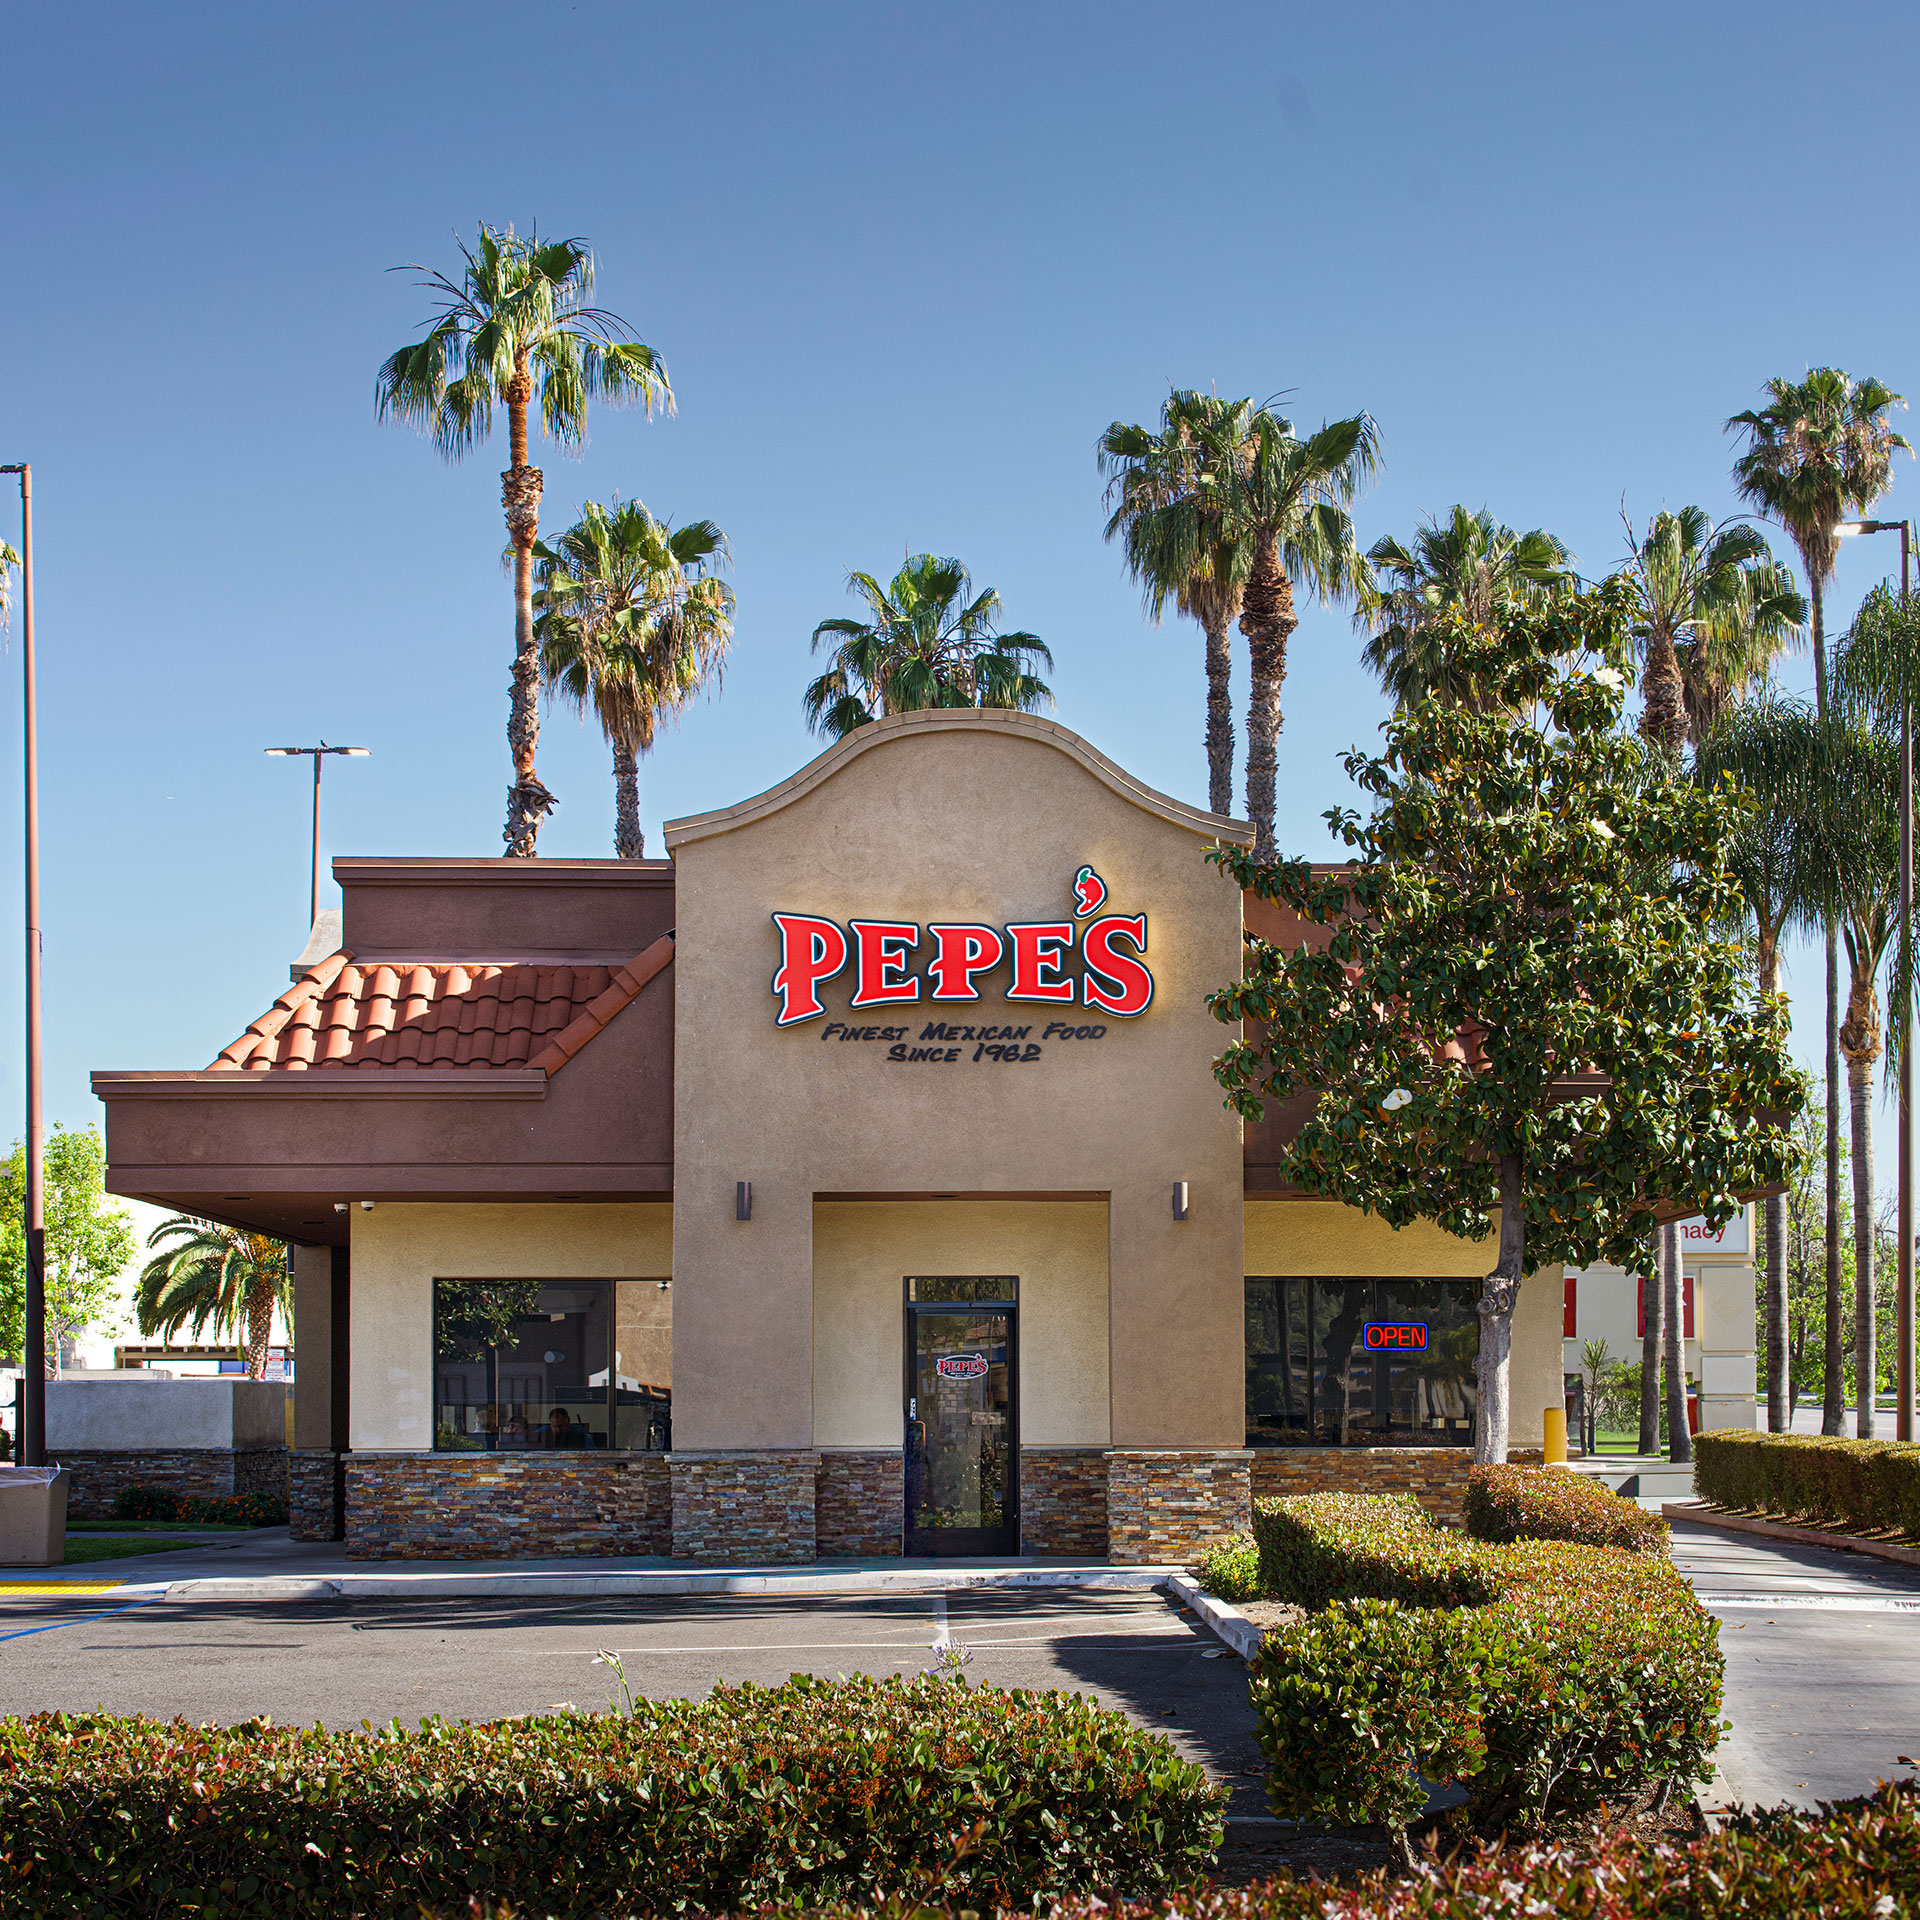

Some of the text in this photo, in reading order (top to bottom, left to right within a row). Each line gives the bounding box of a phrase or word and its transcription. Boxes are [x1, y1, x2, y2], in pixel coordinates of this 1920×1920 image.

[771, 864, 1155, 1028] PEPE'S
[820, 1021, 1108, 1041] FINEST MEXICAN FOOD
[886, 1043, 1042, 1063] SINCE 1962
[1365, 1326, 1426, 1348] OPEN
[938, 1354, 987, 1373] PEPE'S
